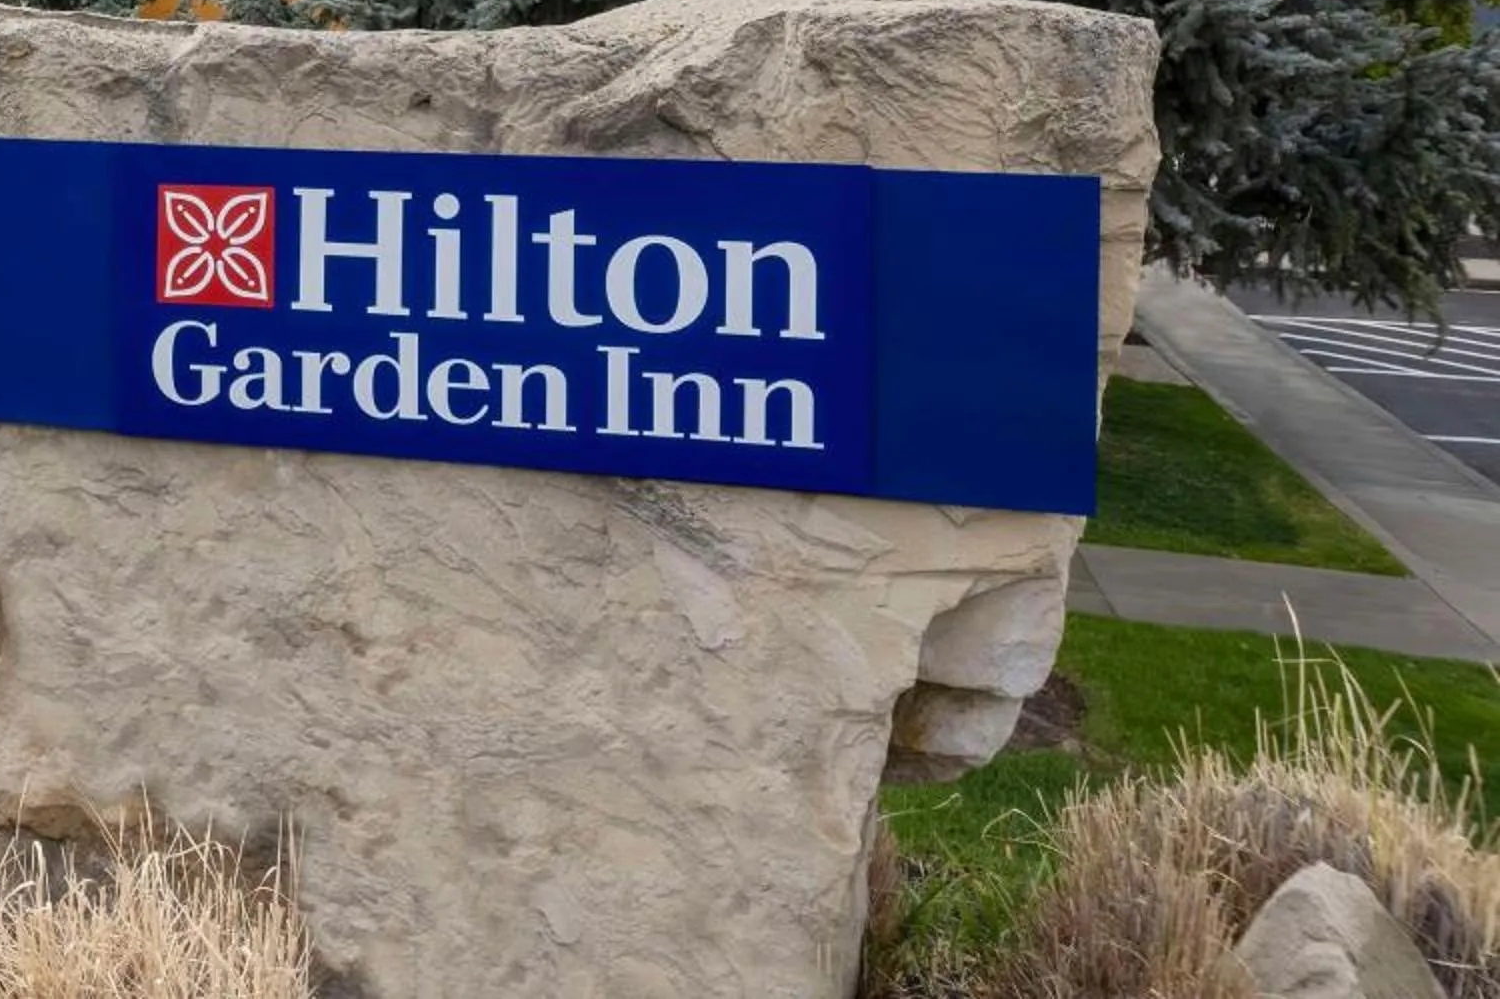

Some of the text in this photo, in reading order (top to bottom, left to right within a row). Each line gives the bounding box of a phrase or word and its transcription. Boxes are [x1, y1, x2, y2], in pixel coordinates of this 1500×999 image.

[290, 187, 826, 340] Hilton
[150, 320, 825, 450] Garden Inn
